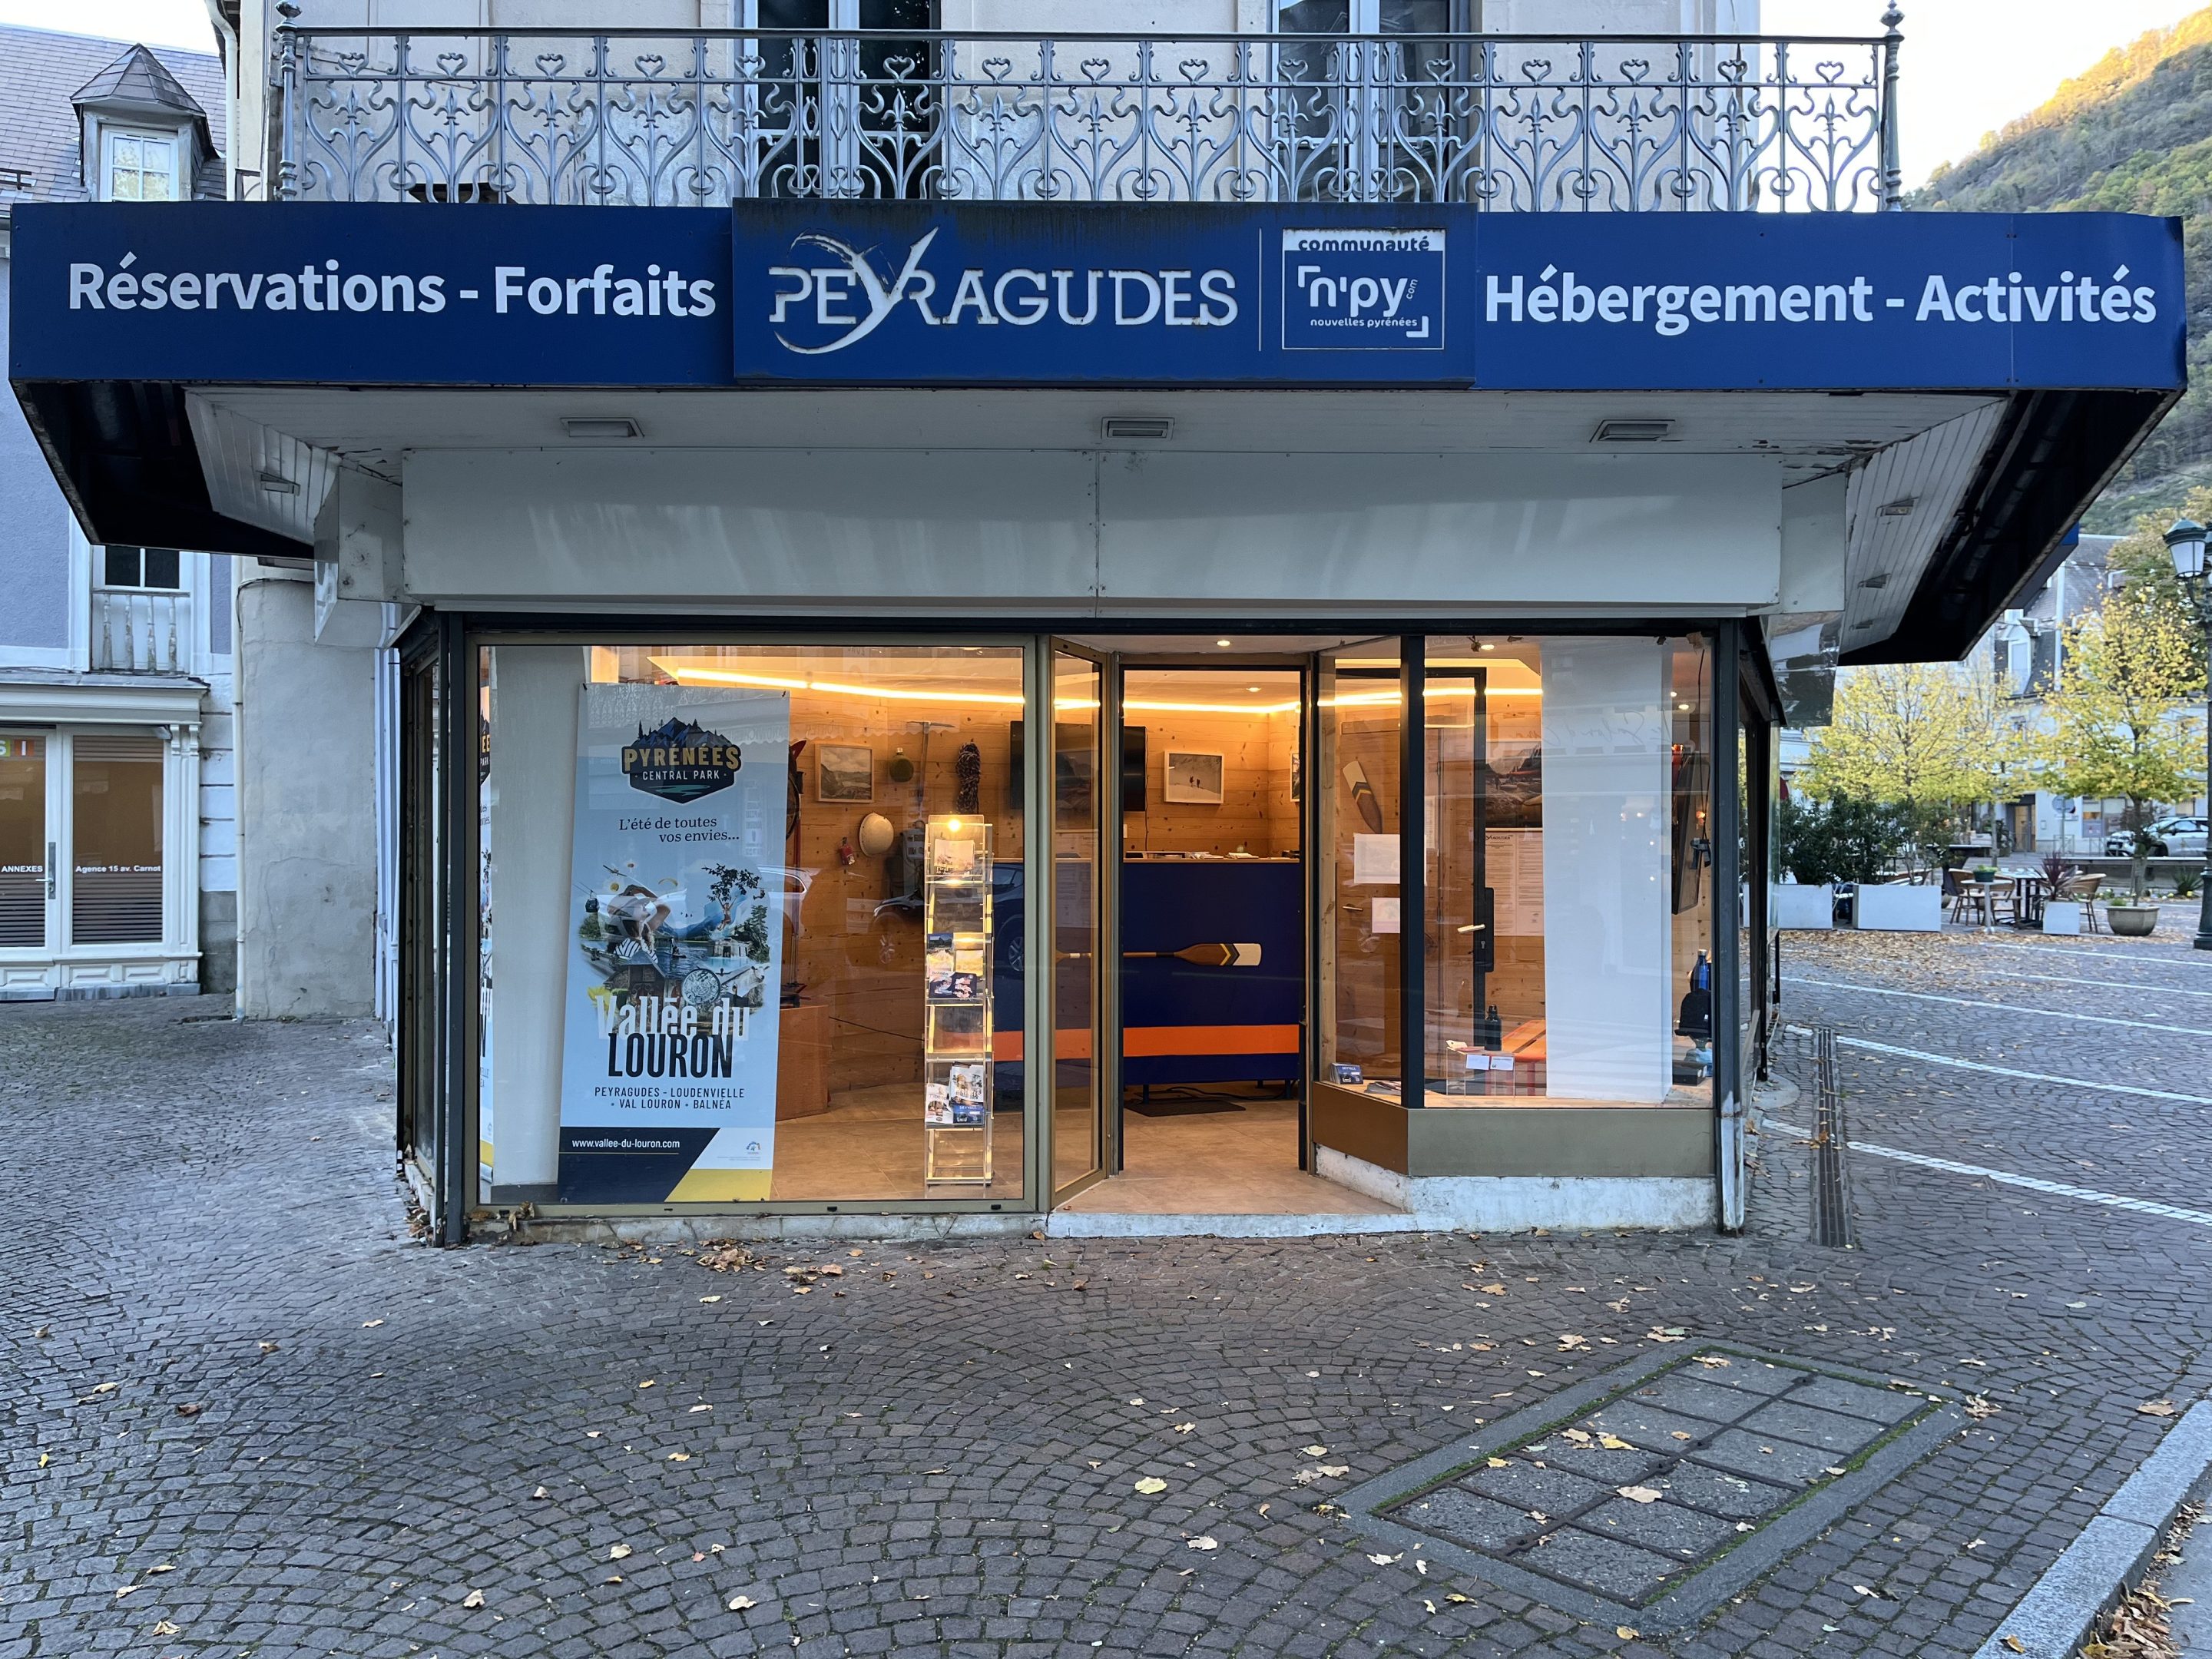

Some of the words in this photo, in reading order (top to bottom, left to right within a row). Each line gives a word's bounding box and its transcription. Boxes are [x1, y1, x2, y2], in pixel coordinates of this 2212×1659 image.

[1298, 236, 1429, 251] communauté
[69, 250, 445, 313] Réservations
[495, 263, 717, 317] Forfaits
[769, 227, 1239, 352] PEYRAGUDES
[1486, 264, 1873, 336] Hébergement
[1916, 265, 2156, 323] Activités
[1310, 317, 1364, 326] nouvelles
[1367, 317, 1417, 328] pyrénées
[624, 743, 741, 770] PYRÉNÉES
[642, 770, 688, 781] CENTRAL
[693, 770, 720, 780] PARK
[619, 818, 652, 830] L'été
[654, 818, 671, 830] de
[674, 816, 717, 829] toutes
[659, 833, 682, 843] vos
[684, 829, 740, 843] envies...
[595, 995, 698, 1038] Vallée
[712, 997, 750, 1041] du
[608, 1032, 733, 1078] LOURON
[594, 1086, 661, 1098] PEYRAGUDES
[671, 1087, 745, 1098] LOUDENVIELLE
[619, 1098, 637, 1109] VAL
[641, 1098, 680, 1109] LOURON
[693, 1096, 731, 1110] BALNÉA
[572, 1138, 680, 1149] www.vallee-du-louron.com
